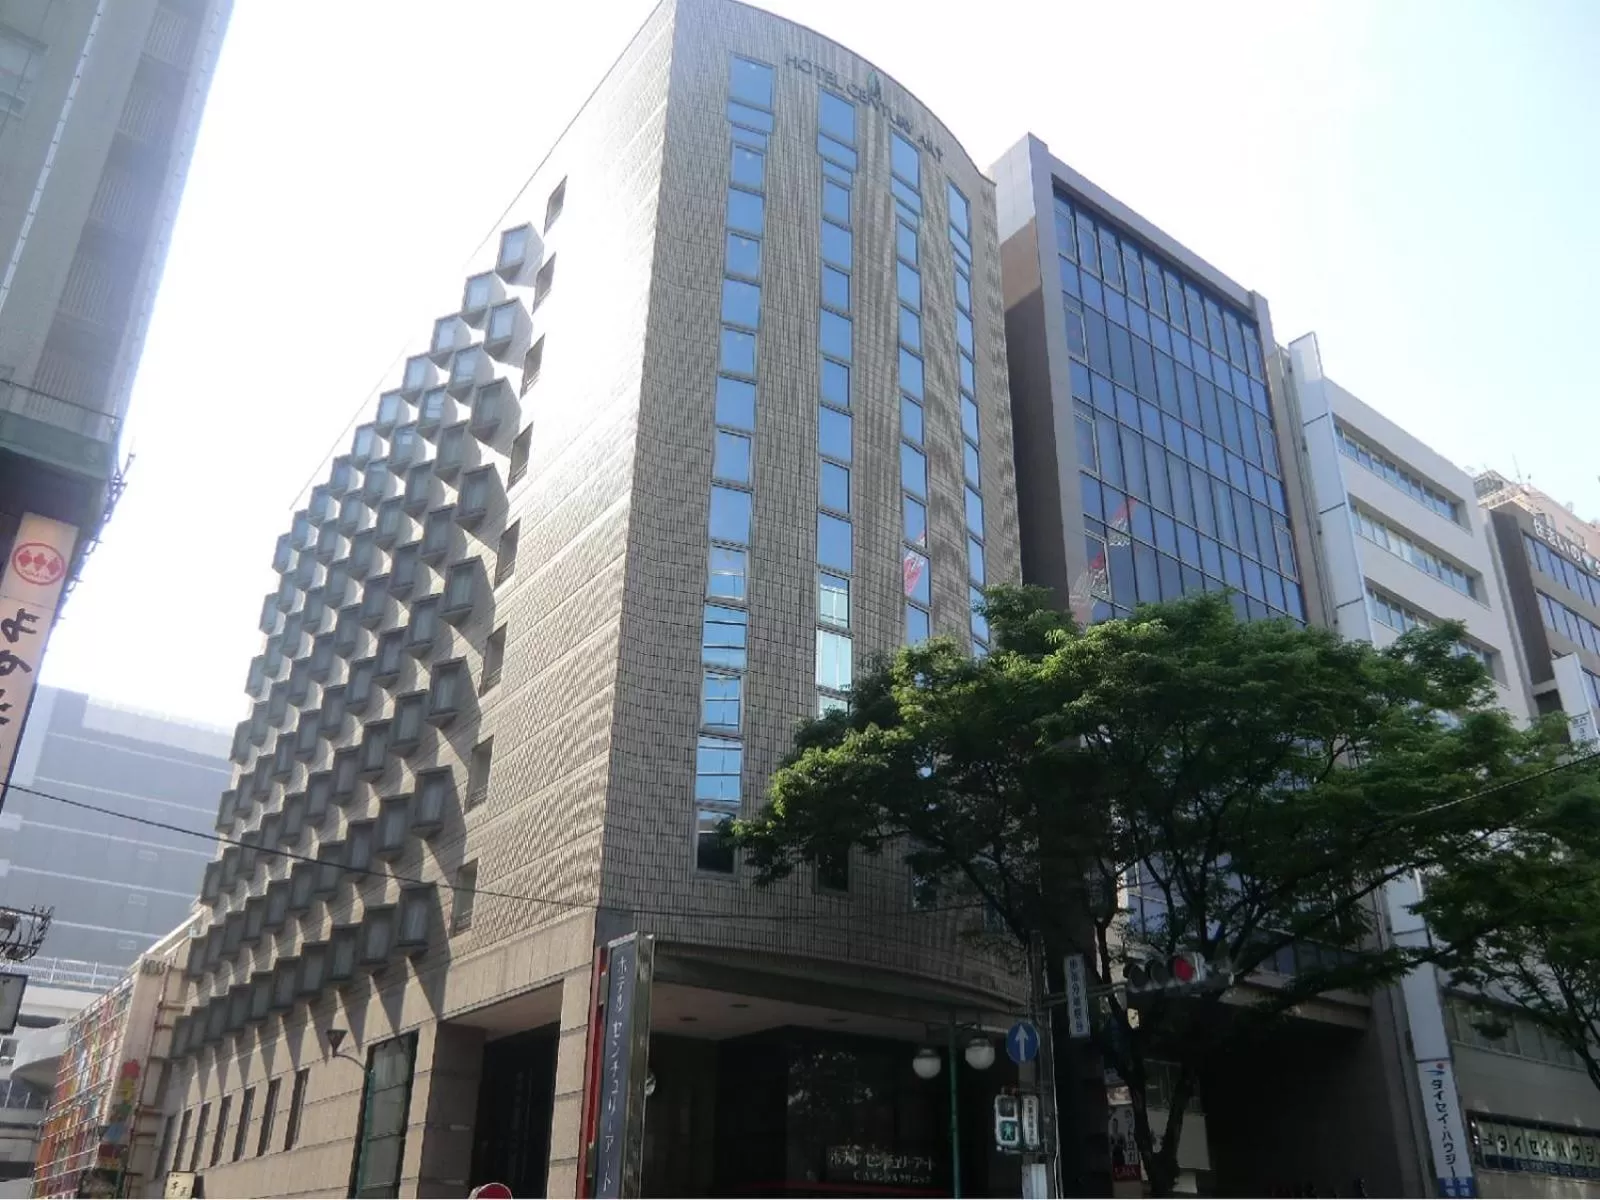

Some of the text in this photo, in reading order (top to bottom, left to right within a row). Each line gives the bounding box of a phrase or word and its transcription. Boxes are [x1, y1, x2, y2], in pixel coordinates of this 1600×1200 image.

[785, 55, 843, 91] HOTEL
[614, 955, 629, 1012] ホテル
[1497, 1134, 1600, 1162] タイセイ・ハウジ
